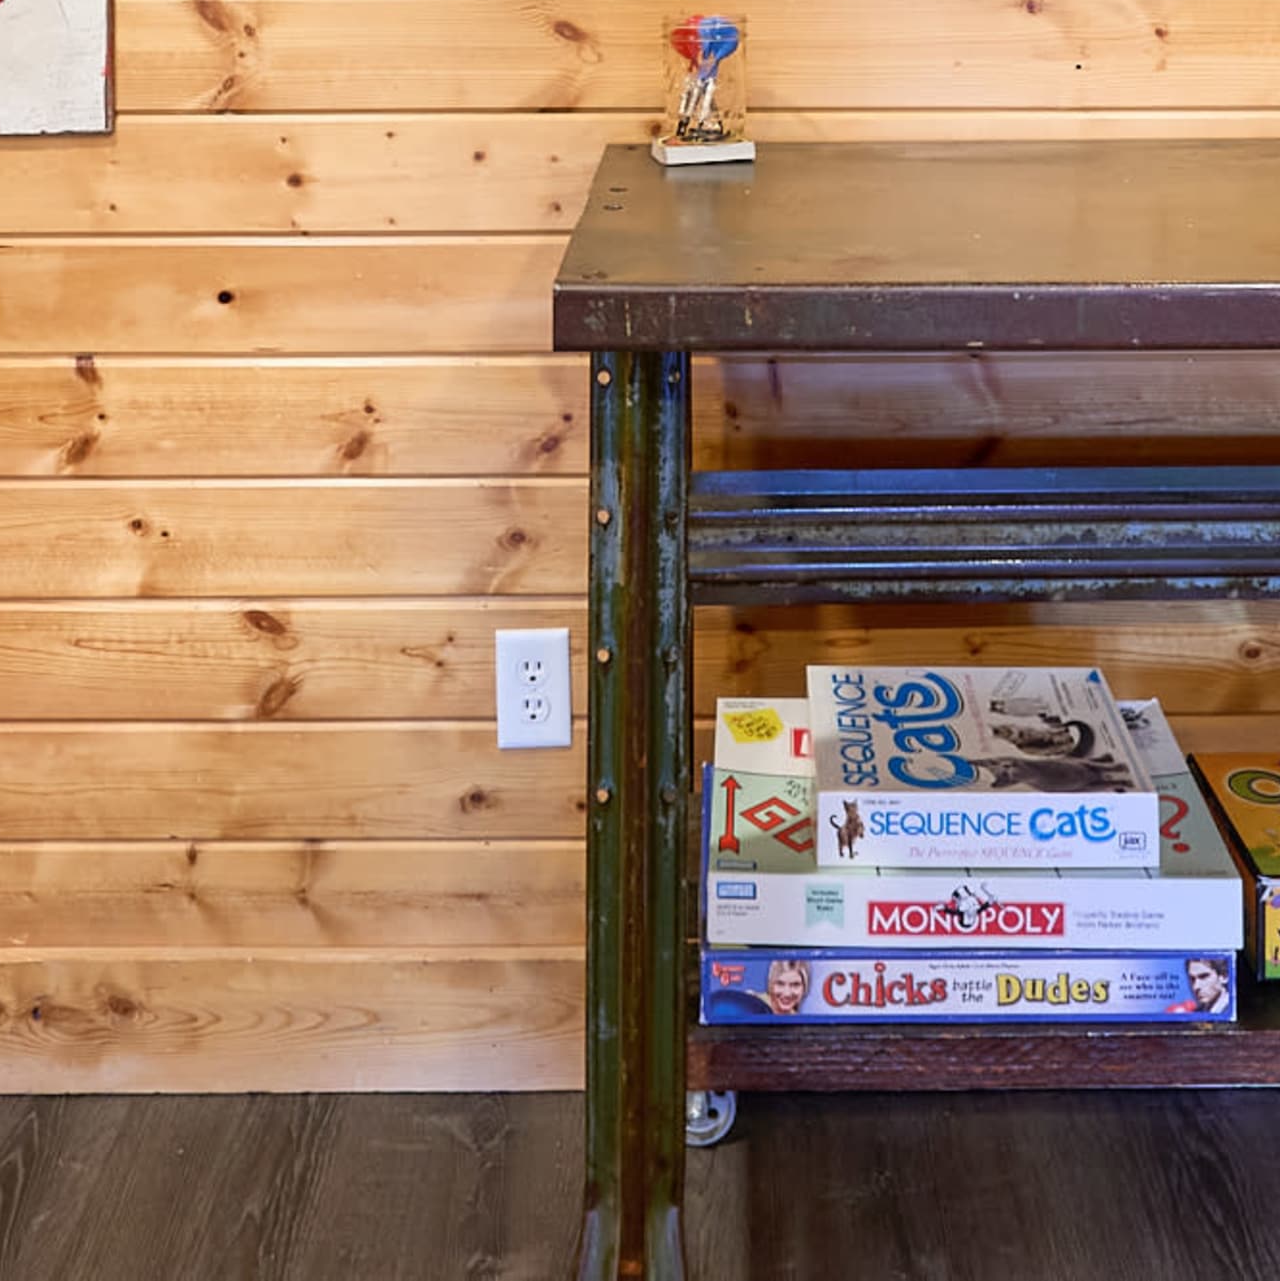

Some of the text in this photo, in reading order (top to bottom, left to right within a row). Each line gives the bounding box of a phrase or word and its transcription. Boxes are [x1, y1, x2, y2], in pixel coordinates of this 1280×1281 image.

[833, 673, 880, 786] SEQUENCE
[870, 811, 1021, 837] SEQUENCE
[872, 905, 1061, 934] MONOPOLY
[822, 960, 948, 1008] Chicks
[952, 978, 992, 992] battle
[961, 992, 983, 1004] the
[996, 972, 1111, 1006] Dudes
